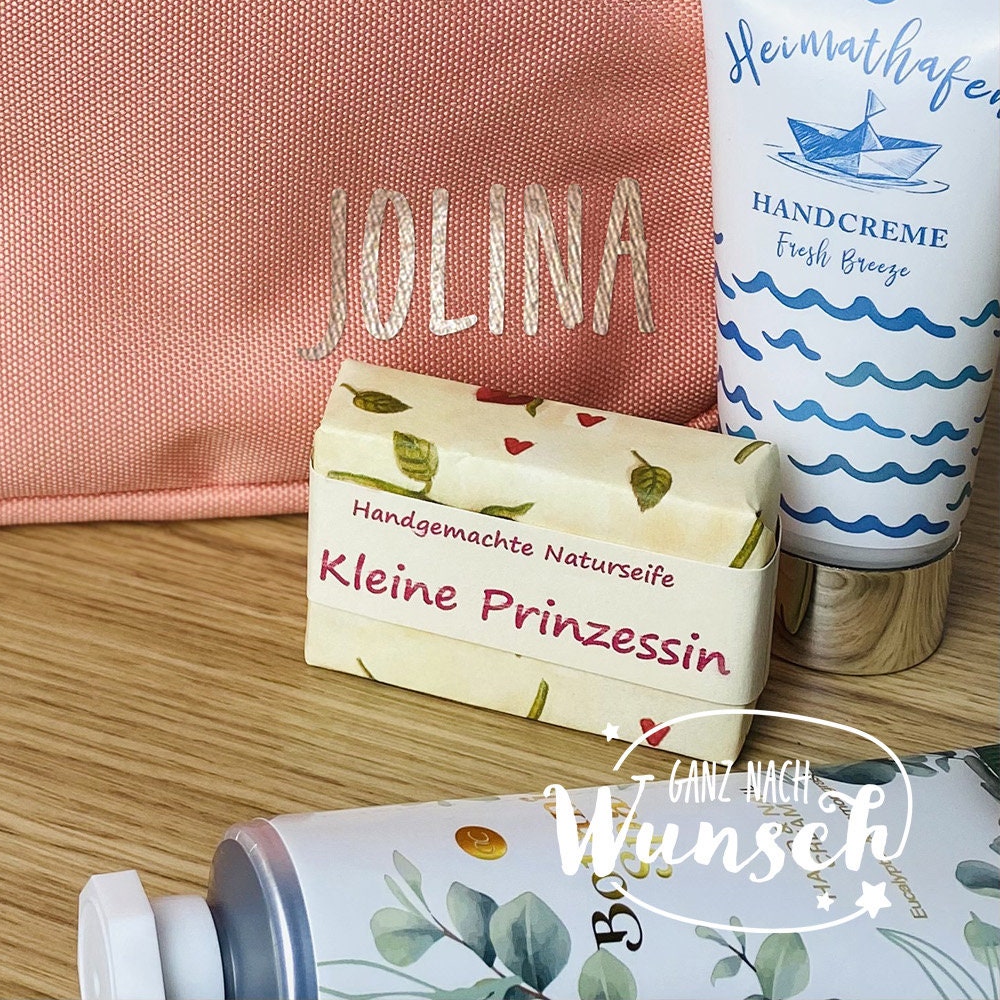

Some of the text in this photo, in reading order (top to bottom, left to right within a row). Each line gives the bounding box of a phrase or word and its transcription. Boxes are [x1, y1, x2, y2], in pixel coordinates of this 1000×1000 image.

[751, 190, 949, 249] HANDCREME
[775, 230, 912, 287] Fresh Breeze
[298, 177, 656, 361] JOLINA
[352, 499, 676, 588] Handgemachte Naturseife
[319, 548, 732, 677] Kleine Prinzessin
